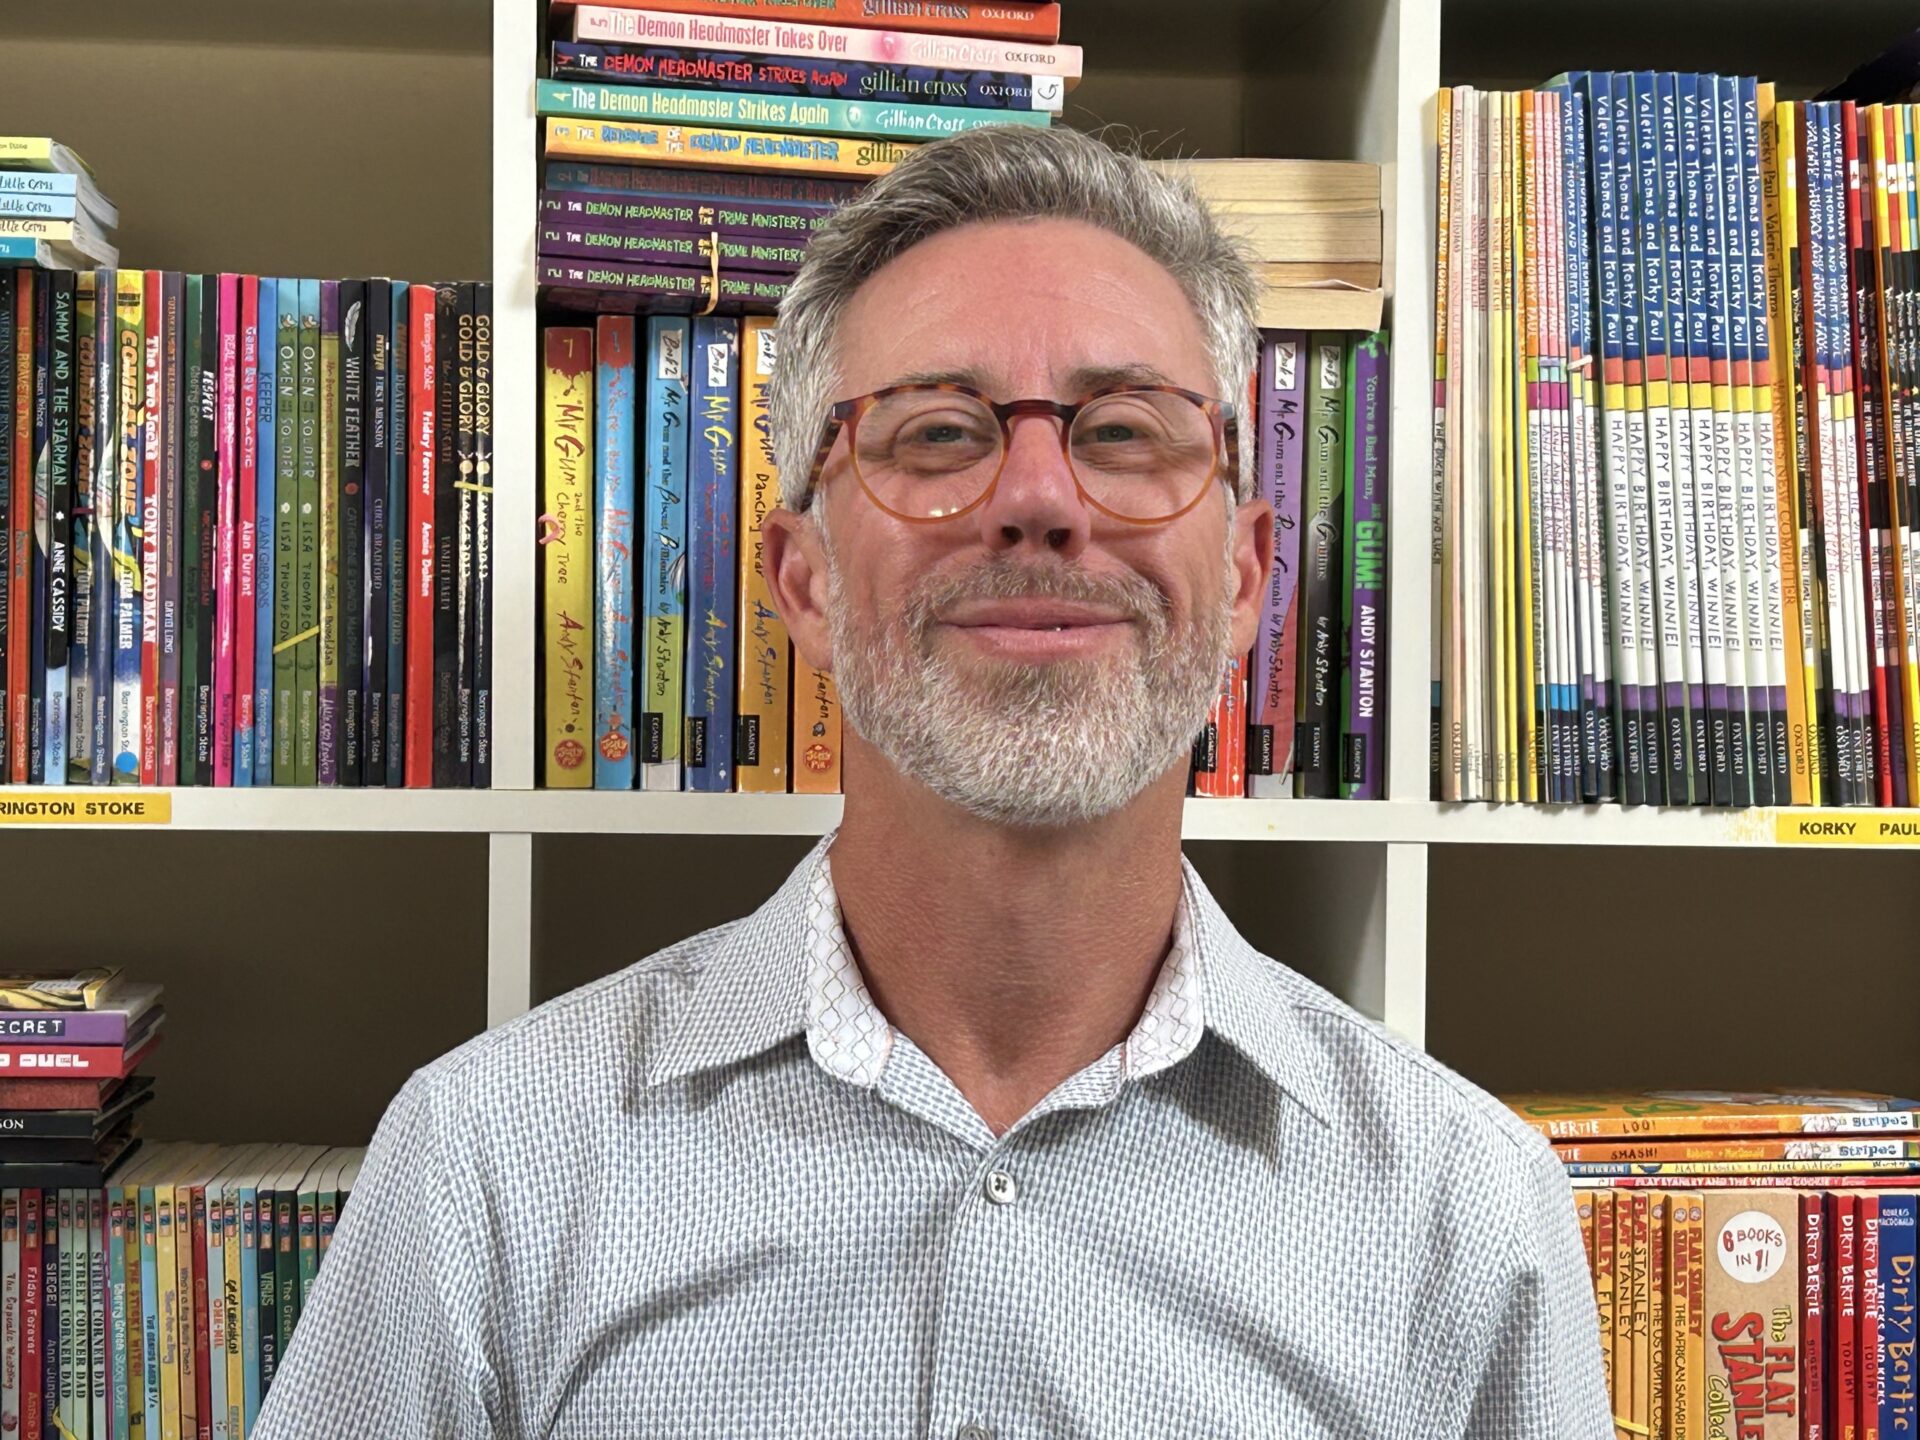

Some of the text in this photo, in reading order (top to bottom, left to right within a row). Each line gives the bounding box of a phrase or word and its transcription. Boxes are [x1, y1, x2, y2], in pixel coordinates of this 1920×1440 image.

[608, 12, 849, 52] The Demon Headmaster Takes Over
[981, 8, 1035, 21] OXFORD
[603, 53, 654, 74] DEMON
[658, 58, 753, 83] HEADMASTER
[758, 66, 806, 85] STRIKES
[859, 69, 968, 97] gillian cross
[1004, 51, 1056, 65] OXFORD
[571, 86, 829, 125] The Demon Headmaster Strikes Again
[979, 84, 1033, 98] OXFORD
[876, 110, 925, 129] Gillian
[926, 114, 965, 132] Cross
[586, 201, 806, 230] DEMON HEADMASTER PRIME MINISTER'S
[1640, 93, 1663, 341] Valerie Thomas and Korky Paul
[1745, 100, 1768, 347] Valerie Thomas and Korky Paul
[585, 233, 749, 258] DEMON HEADMASTER PRIME
[587, 270, 751, 295] DEMON HEADMASTER PRIME
[459, 314, 473, 362] GOLD
[53, 292, 70, 487] SAMMY AND THE STARMAN
[145, 335, 159, 461] The Two Jacks
[259, 372, 272, 424] KEEPER
[280, 345, 294, 478] OWEN SOLDIER
[345, 356, 360, 468] WHITE FEATHER
[459, 381, 473, 435] GLORY
[701, 395, 731, 423] Mr
[555, 403, 585, 433] Mr
[1270, 398, 1298, 460] Mr Gum
[1315, 396, 1341, 491] Mr Gum and
[1655, 417, 1669, 472] HAPPY
[420, 410, 433, 496] Friday Forever
[1699, 419, 1712, 475] HAPPY
[281, 521, 291, 553] LISA
[1658, 481, 1673, 569] BIRTHDAY,
[1701, 483, 1717, 571] BIRTHDAY,
[142, 491, 157, 643] TONY BRADMAN
[241, 521, 253, 597] Alan Durant
[421, 521, 432, 597] Annie Dalton
[1355, 520, 1383, 590] GUM!
[52, 542, 65, 632] ANNE CASSIDY
[556, 610, 585, 715] Andy Stanton
[655, 618, 672, 696] Andy Stanton
[1269, 628, 1283, 708] Andy Stanton
[1315, 657, 1329, 706] Stanton
[1358, 605, 1376, 718] ANDY STANTON
[119, 690, 131, 738] Barrington
[197, 684, 209, 762] Barrington Stoke
[345, 689, 357, 766] Barrington Stoke
[747, 719, 756, 761] EGMONT
[695, 721, 703, 762] EGMONT
[1261, 729, 1270, 771] EGMONT
[1671, 718, 1684, 771] OXFORD
[1731, 722, 1744, 775] OXFORD
[1793, 723, 1806, 775] OXFORD
[85, 802, 145, 815] STOKE
[1800, 822, 1920, 836] KORKY PAUL
[1550, 1119, 1657, 1136] BERTIE LOO!
[1611, 1147, 1659, 1160] SMASH!
[1723, 1226, 1783, 1251] 6 BOOKS
[1736, 1249, 1770, 1273] IN 1!
[1806, 1213, 1820, 1318] DIRTY BERTIE
[46, 1263, 57, 1307] SIEGE!
[261, 1272, 274, 1306] VIRUS
[1633, 1248, 1647, 1337] STANLEY
[1841, 1214, 1855, 1318] DIRTY BERTIE
[25, 1266, 37, 1355] Friday Forever
[1618, 1251, 1632, 1341] STANLEY
[60, 1251, 72, 1399] STREET CORNER DAD
[1772, 1305, 1793, 1343] The
[1877, 1283, 1886, 1406] TRICKS AND KICKS
[1887, 1255, 1916, 1431] Dirty Bertie
[1675, 1303, 1687, 1425] THE AFRICAN SAFARI
[1764, 1345, 1797, 1418] FLAT
